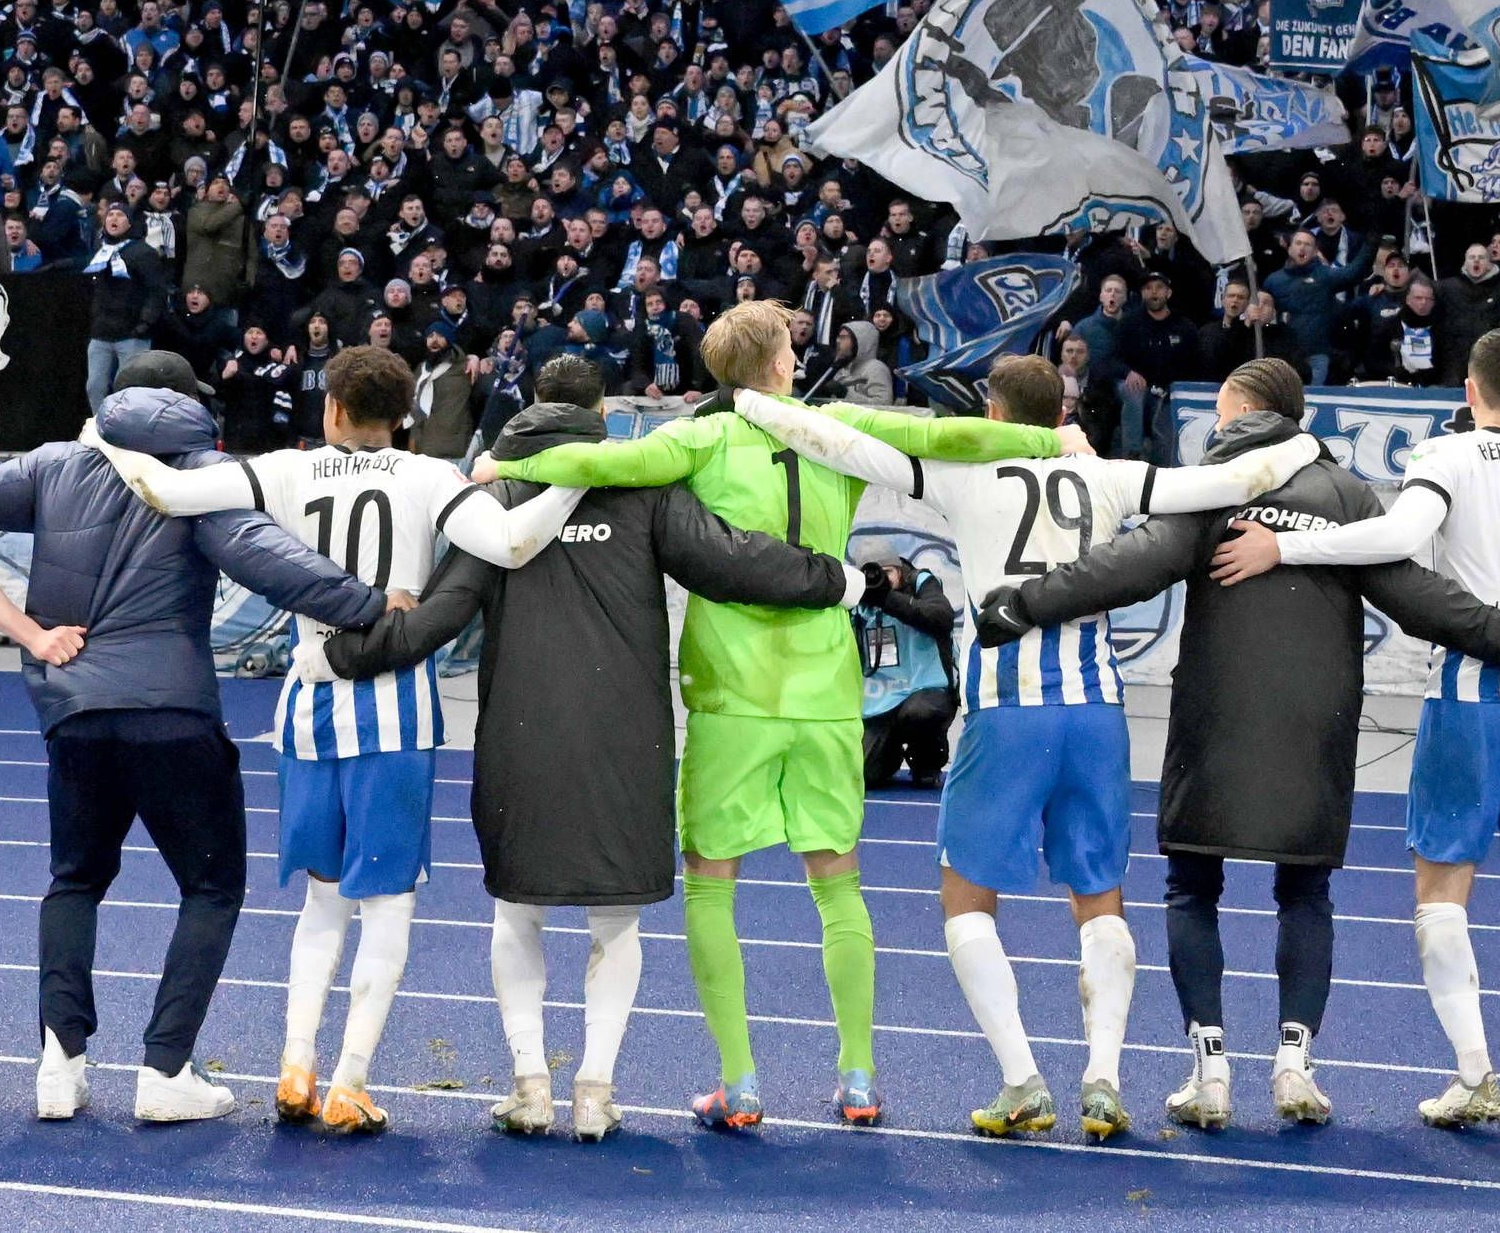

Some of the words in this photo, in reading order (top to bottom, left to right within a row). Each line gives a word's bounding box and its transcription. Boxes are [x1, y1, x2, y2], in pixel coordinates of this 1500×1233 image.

[1275, 20, 1290, 32] DIE
[1293, 21, 1333, 35] ZUKUNFT
[1282, 34, 1315, 58] DEN
[1319, 37, 1352, 60] FAN
[304, 489, 393, 593] 10
[771, 447, 800, 547] 1
[996, 465, 1093, 576] 29
